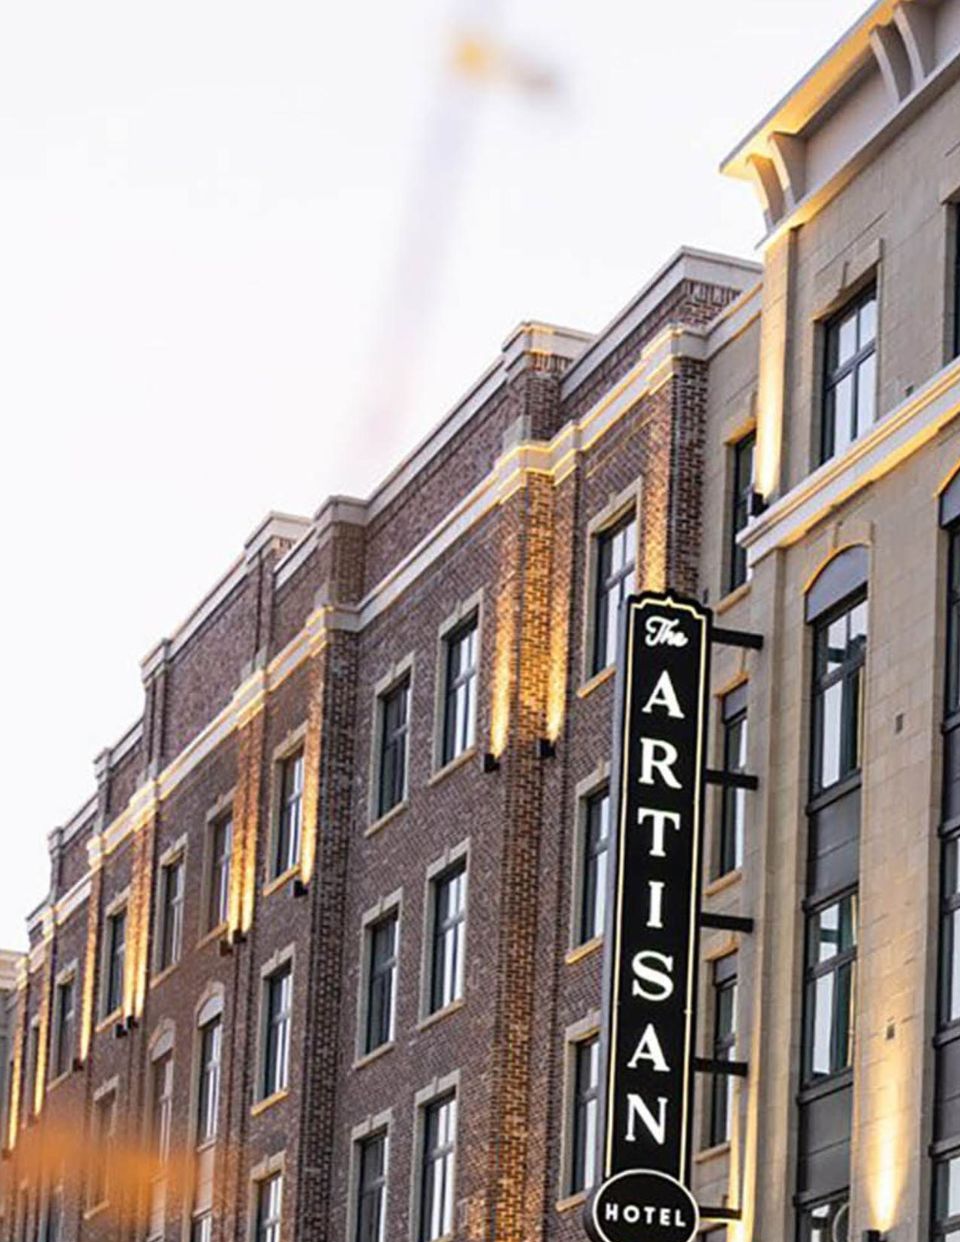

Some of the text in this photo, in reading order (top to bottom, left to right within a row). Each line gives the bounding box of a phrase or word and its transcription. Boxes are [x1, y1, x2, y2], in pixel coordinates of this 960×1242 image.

[645, 615, 689, 647] The
[625, 670, 685, 1145] ARTISAN
[605, 1202, 687, 1227] HOTEL
